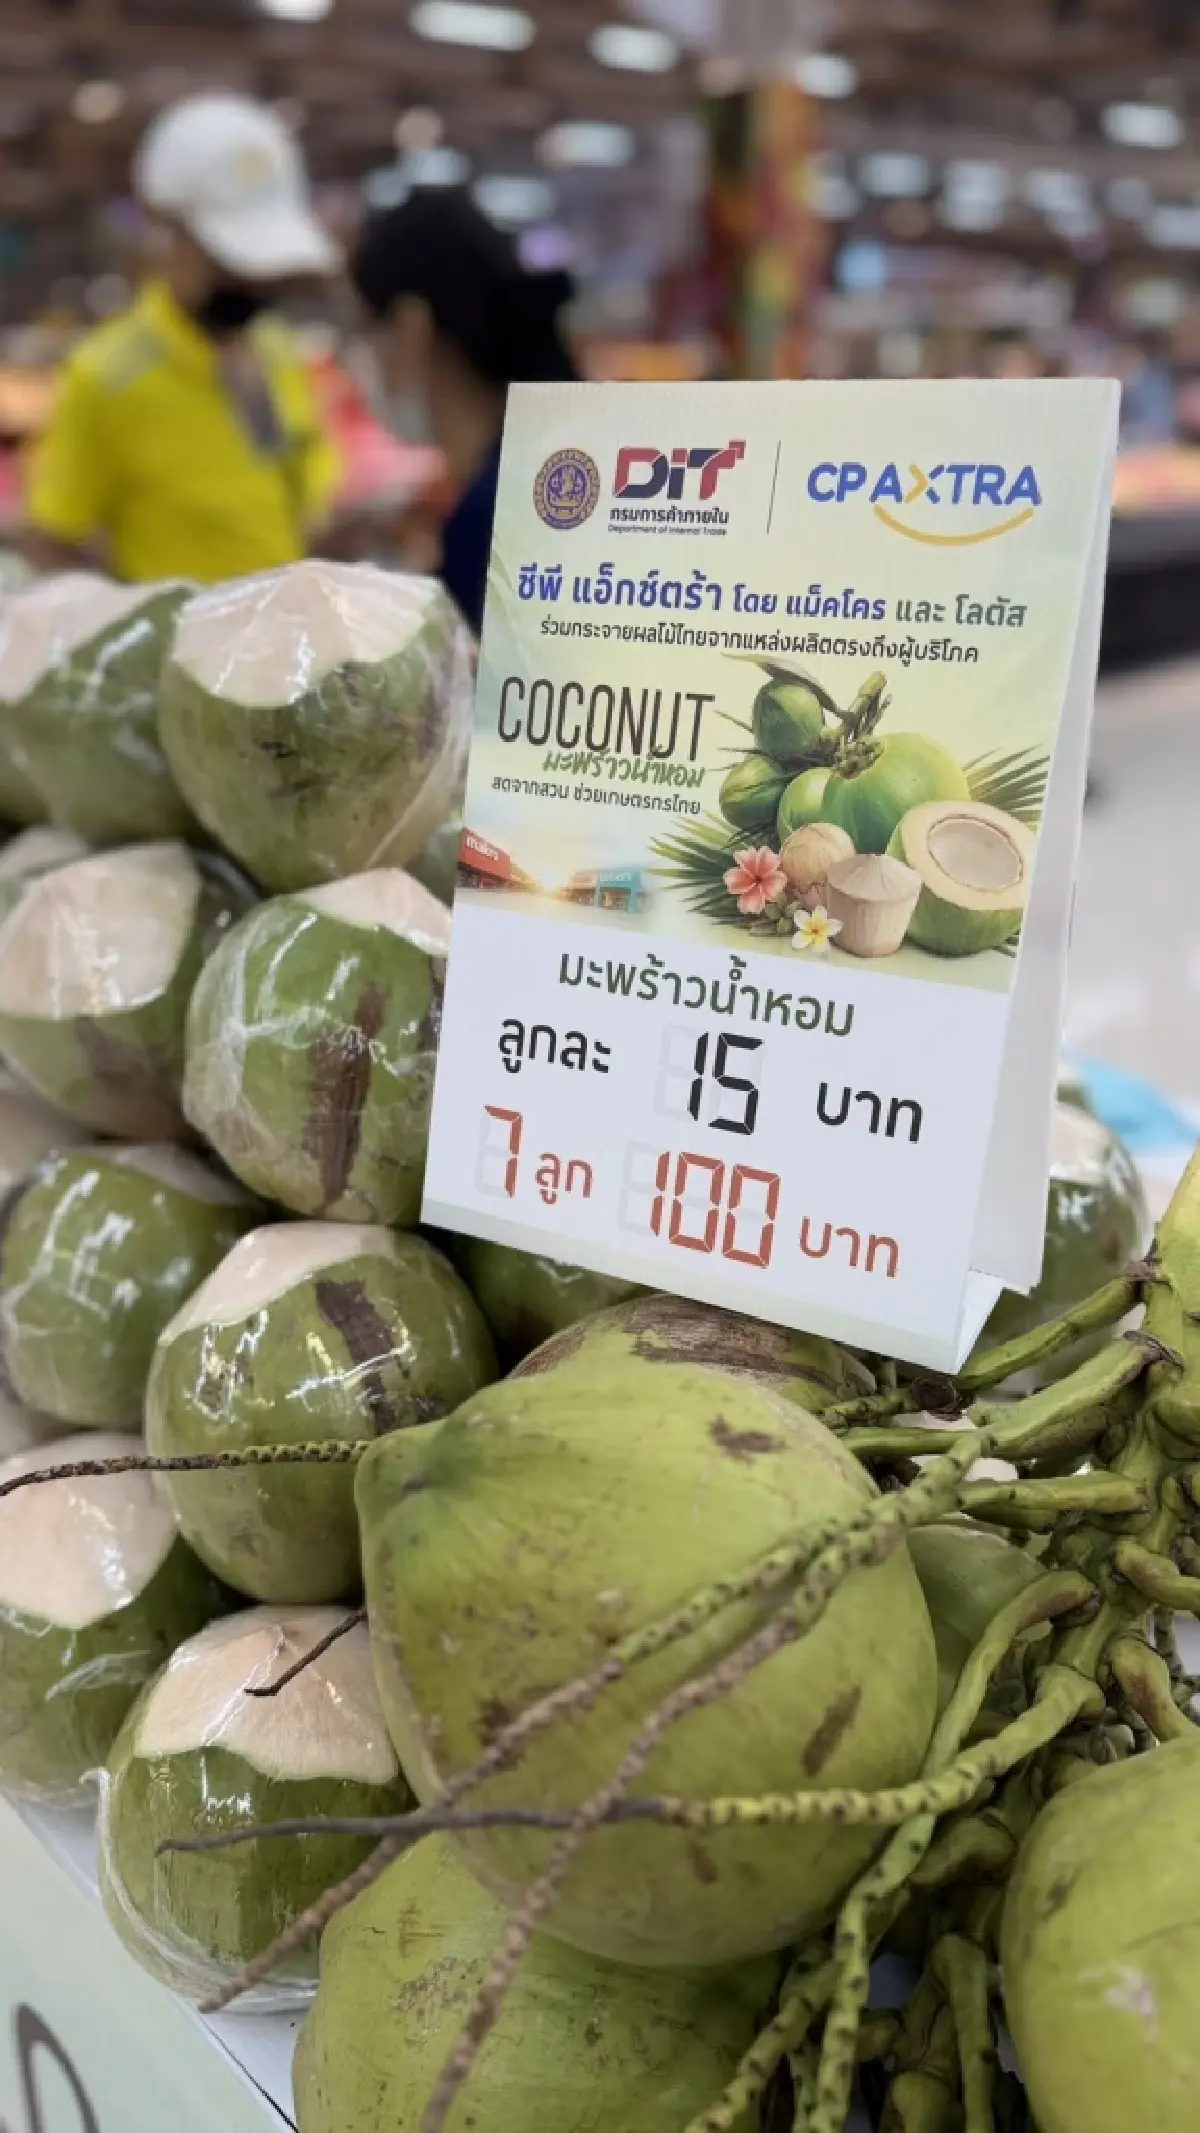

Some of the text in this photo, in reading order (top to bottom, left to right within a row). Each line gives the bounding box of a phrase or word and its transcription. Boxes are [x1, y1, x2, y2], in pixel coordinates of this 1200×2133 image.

[607, 524, 657, 534] Department
[669, 526, 701, 535] Internal
[703, 526, 728, 536] Trade
[609, 504, 730, 524] กรมการค้าภายใน
[732, 583, 778, 614] โดย
[786, 583, 887, 620] แม็คโคร
[895, 598, 947, 624] และ
[955, 593, 1028, 628] โลตัส
[540, 614, 979, 668] ร่วมกระจายผลไม้ไทยจากแหล่งผลิตตรงถึงผู้บริโภค
[498, 676, 716, 762] COCONUT
[542, 744, 706, 788] มะพร้าวน้ำหอม
[559, 951, 855, 1037] มะพร้าวน้ำหอม
[498, 1018, 924, 1142] ลูกละ 15 บาท
[484, 1104, 899, 1278] 7 ลูก 100 บาท
